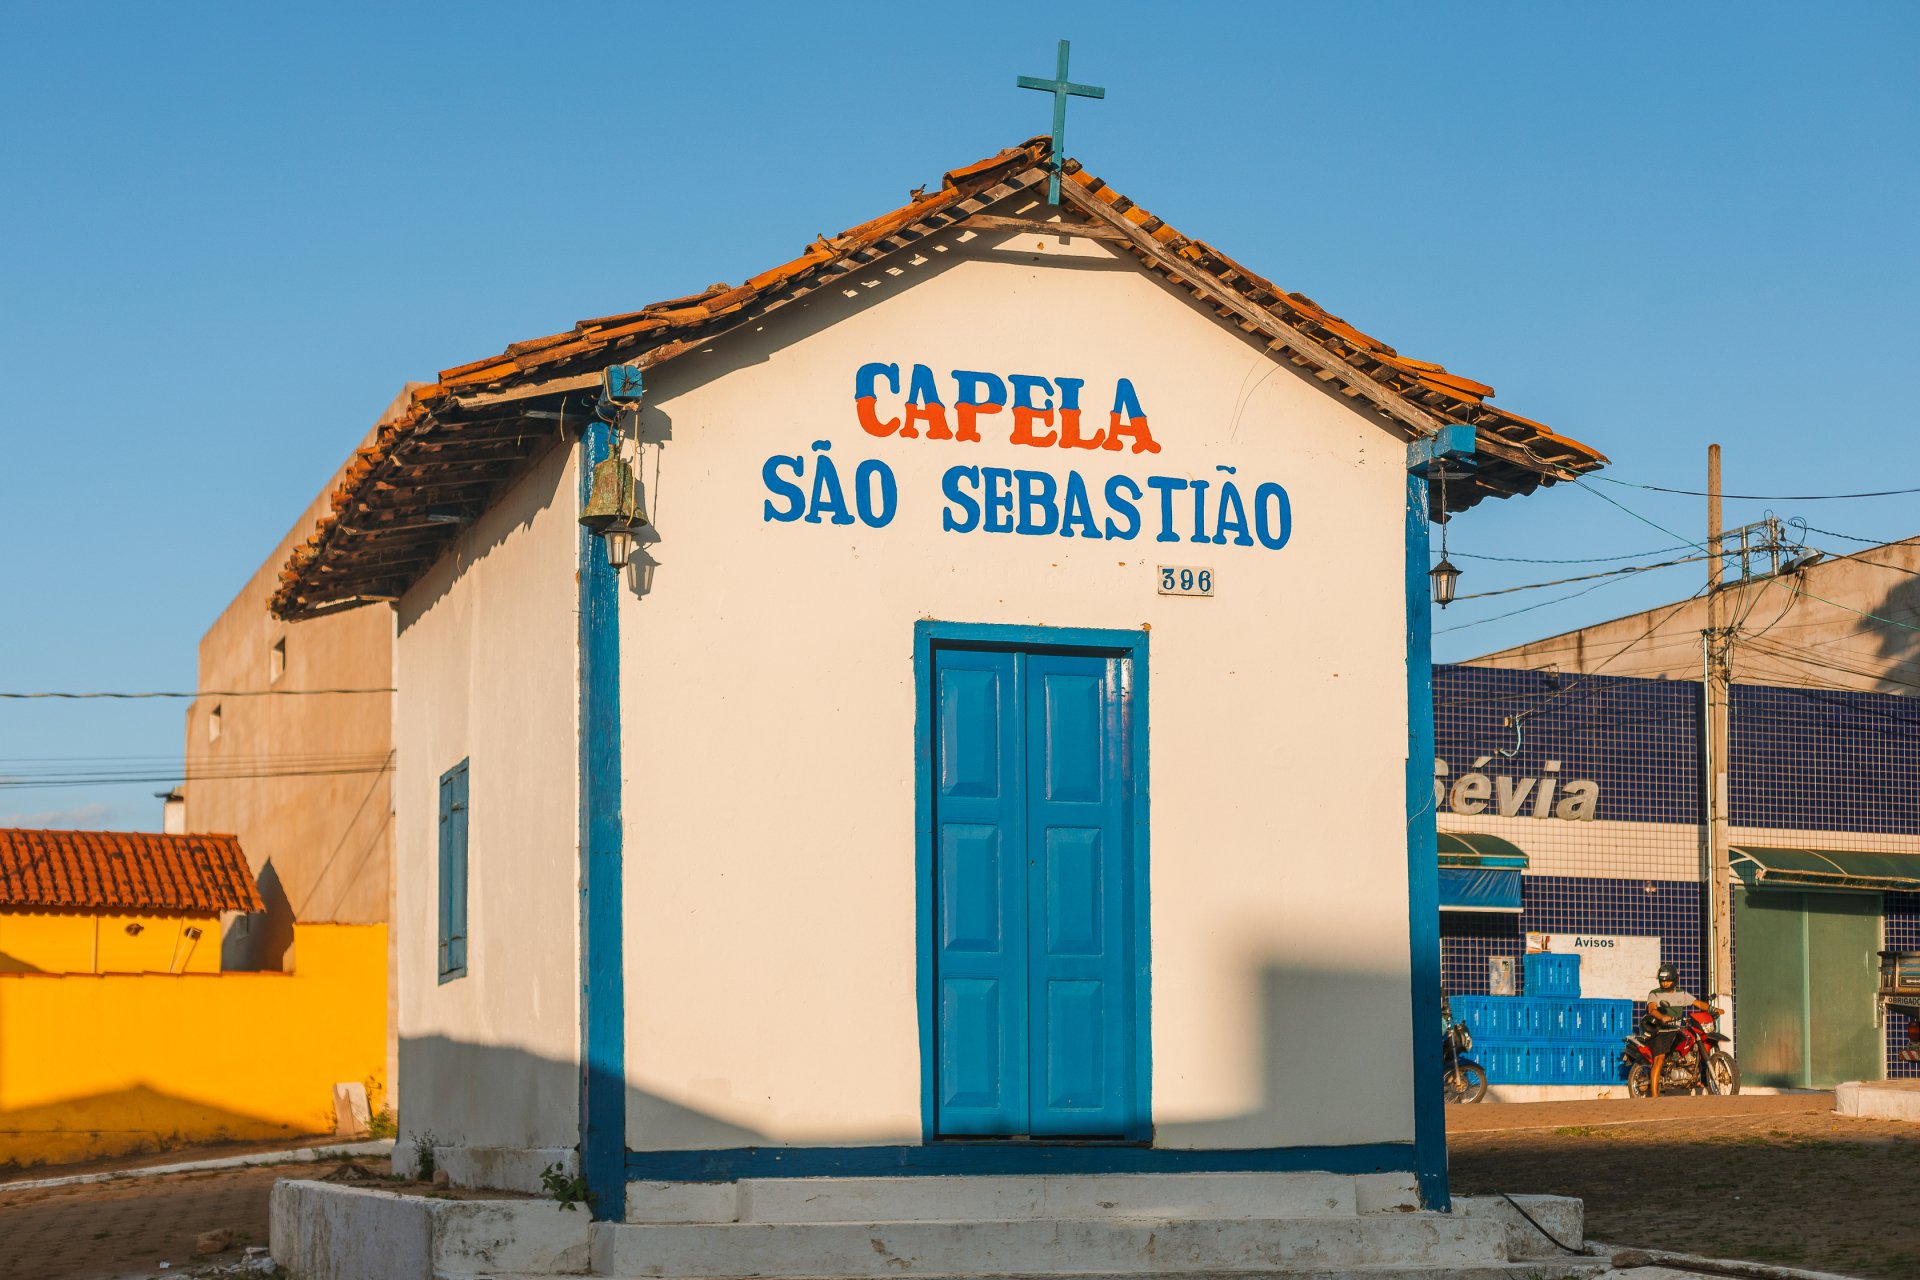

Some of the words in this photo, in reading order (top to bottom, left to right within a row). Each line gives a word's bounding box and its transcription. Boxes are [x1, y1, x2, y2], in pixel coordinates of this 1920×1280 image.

[854, 363, 1161, 454] CAPELA
[762, 440, 897, 528] SÃO
[942, 465, 1291, 550] SEBASTIÃO
[1161, 568, 1211, 592] 396
[1574, 936, 1615, 948] Avisos
